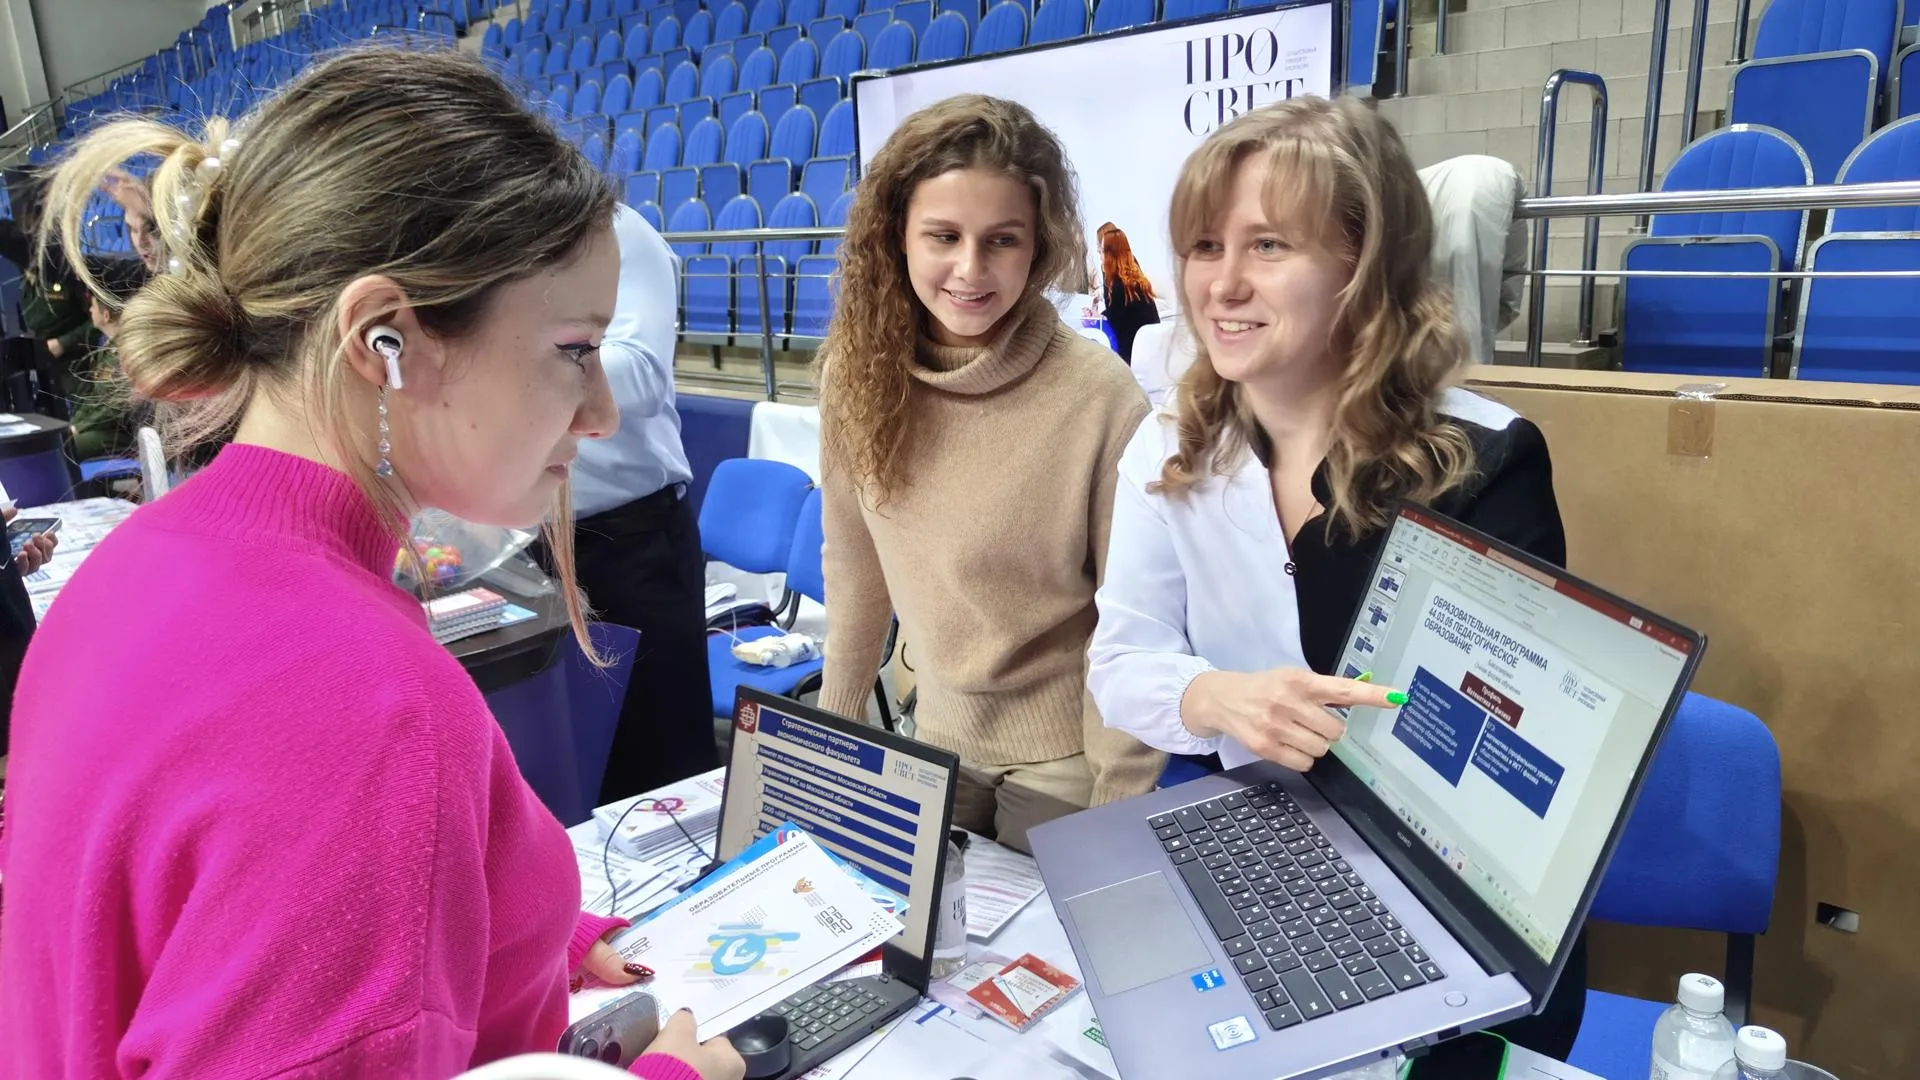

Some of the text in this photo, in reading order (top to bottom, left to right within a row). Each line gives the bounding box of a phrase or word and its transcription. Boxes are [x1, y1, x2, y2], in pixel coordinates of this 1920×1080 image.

[1184, 27, 1278, 85] ПРО
[1424, 617, 1473, 655] ОБРАЗОВАНИЕ
[1428, 607, 1519, 668] 44.03.05 ПЕДАГОГИЧЕСКОЕ
[1433, 595, 1500, 641] ОБРАЗОВАТЕЛЬНАЯ
[1500, 634, 1548, 671] ПРОГРАММА
[777, 730, 861, 765] экономического факультета
[781, 717, 859, 752] Стратегические партнеры
[837, 775, 866, 792] Московской
[688, 867, 761, 913] ОБРАЗОВАТЕЛЬНЫЕ
[760, 841, 806, 869] ПРОГРАММЫ
[820, 910, 846, 934] СВЕТ
[827, 905, 853, 930] ПРО
[618, 936, 648, 955] РО
[623, 941, 650, 960] ВЕТ
